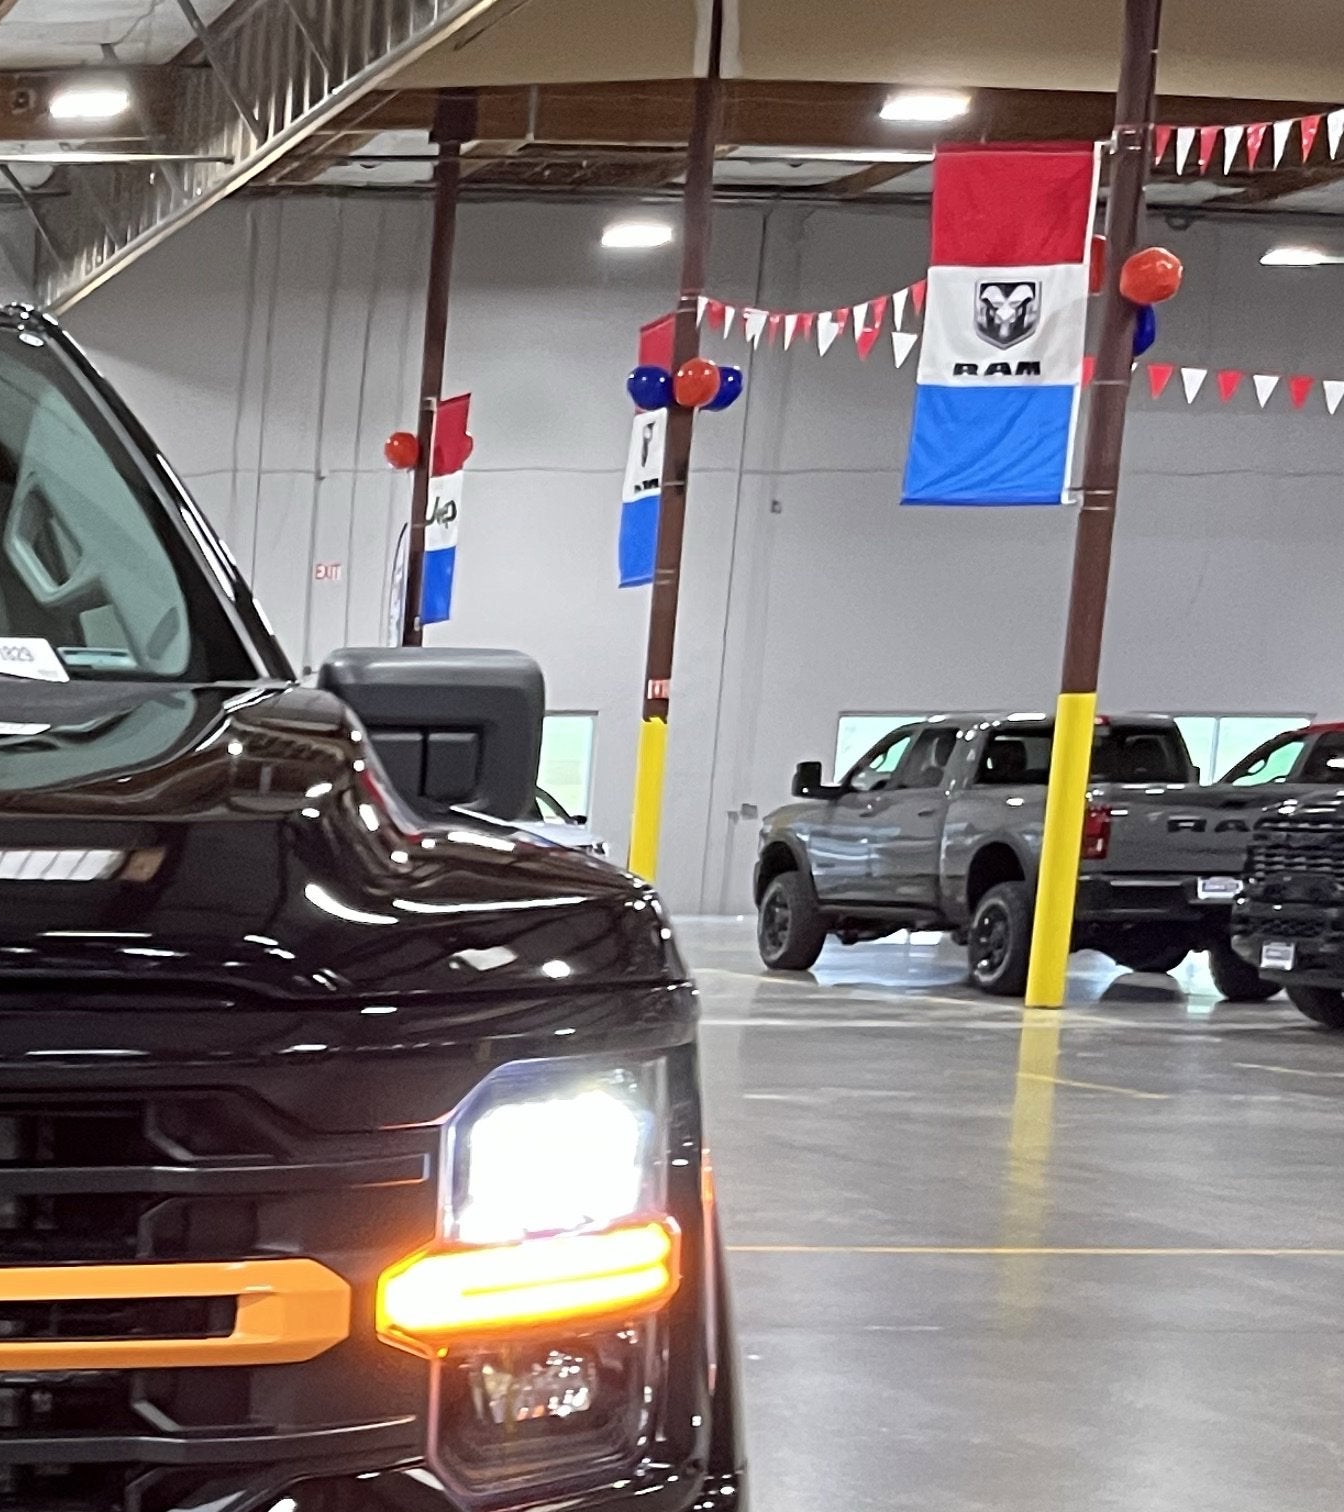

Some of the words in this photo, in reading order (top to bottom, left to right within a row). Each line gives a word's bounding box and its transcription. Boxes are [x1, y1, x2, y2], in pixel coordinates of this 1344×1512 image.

[953, 361, 1041, 376] RAM
[315, 563, 341, 580] EXIT
[1167, 818, 1251, 833] RA
